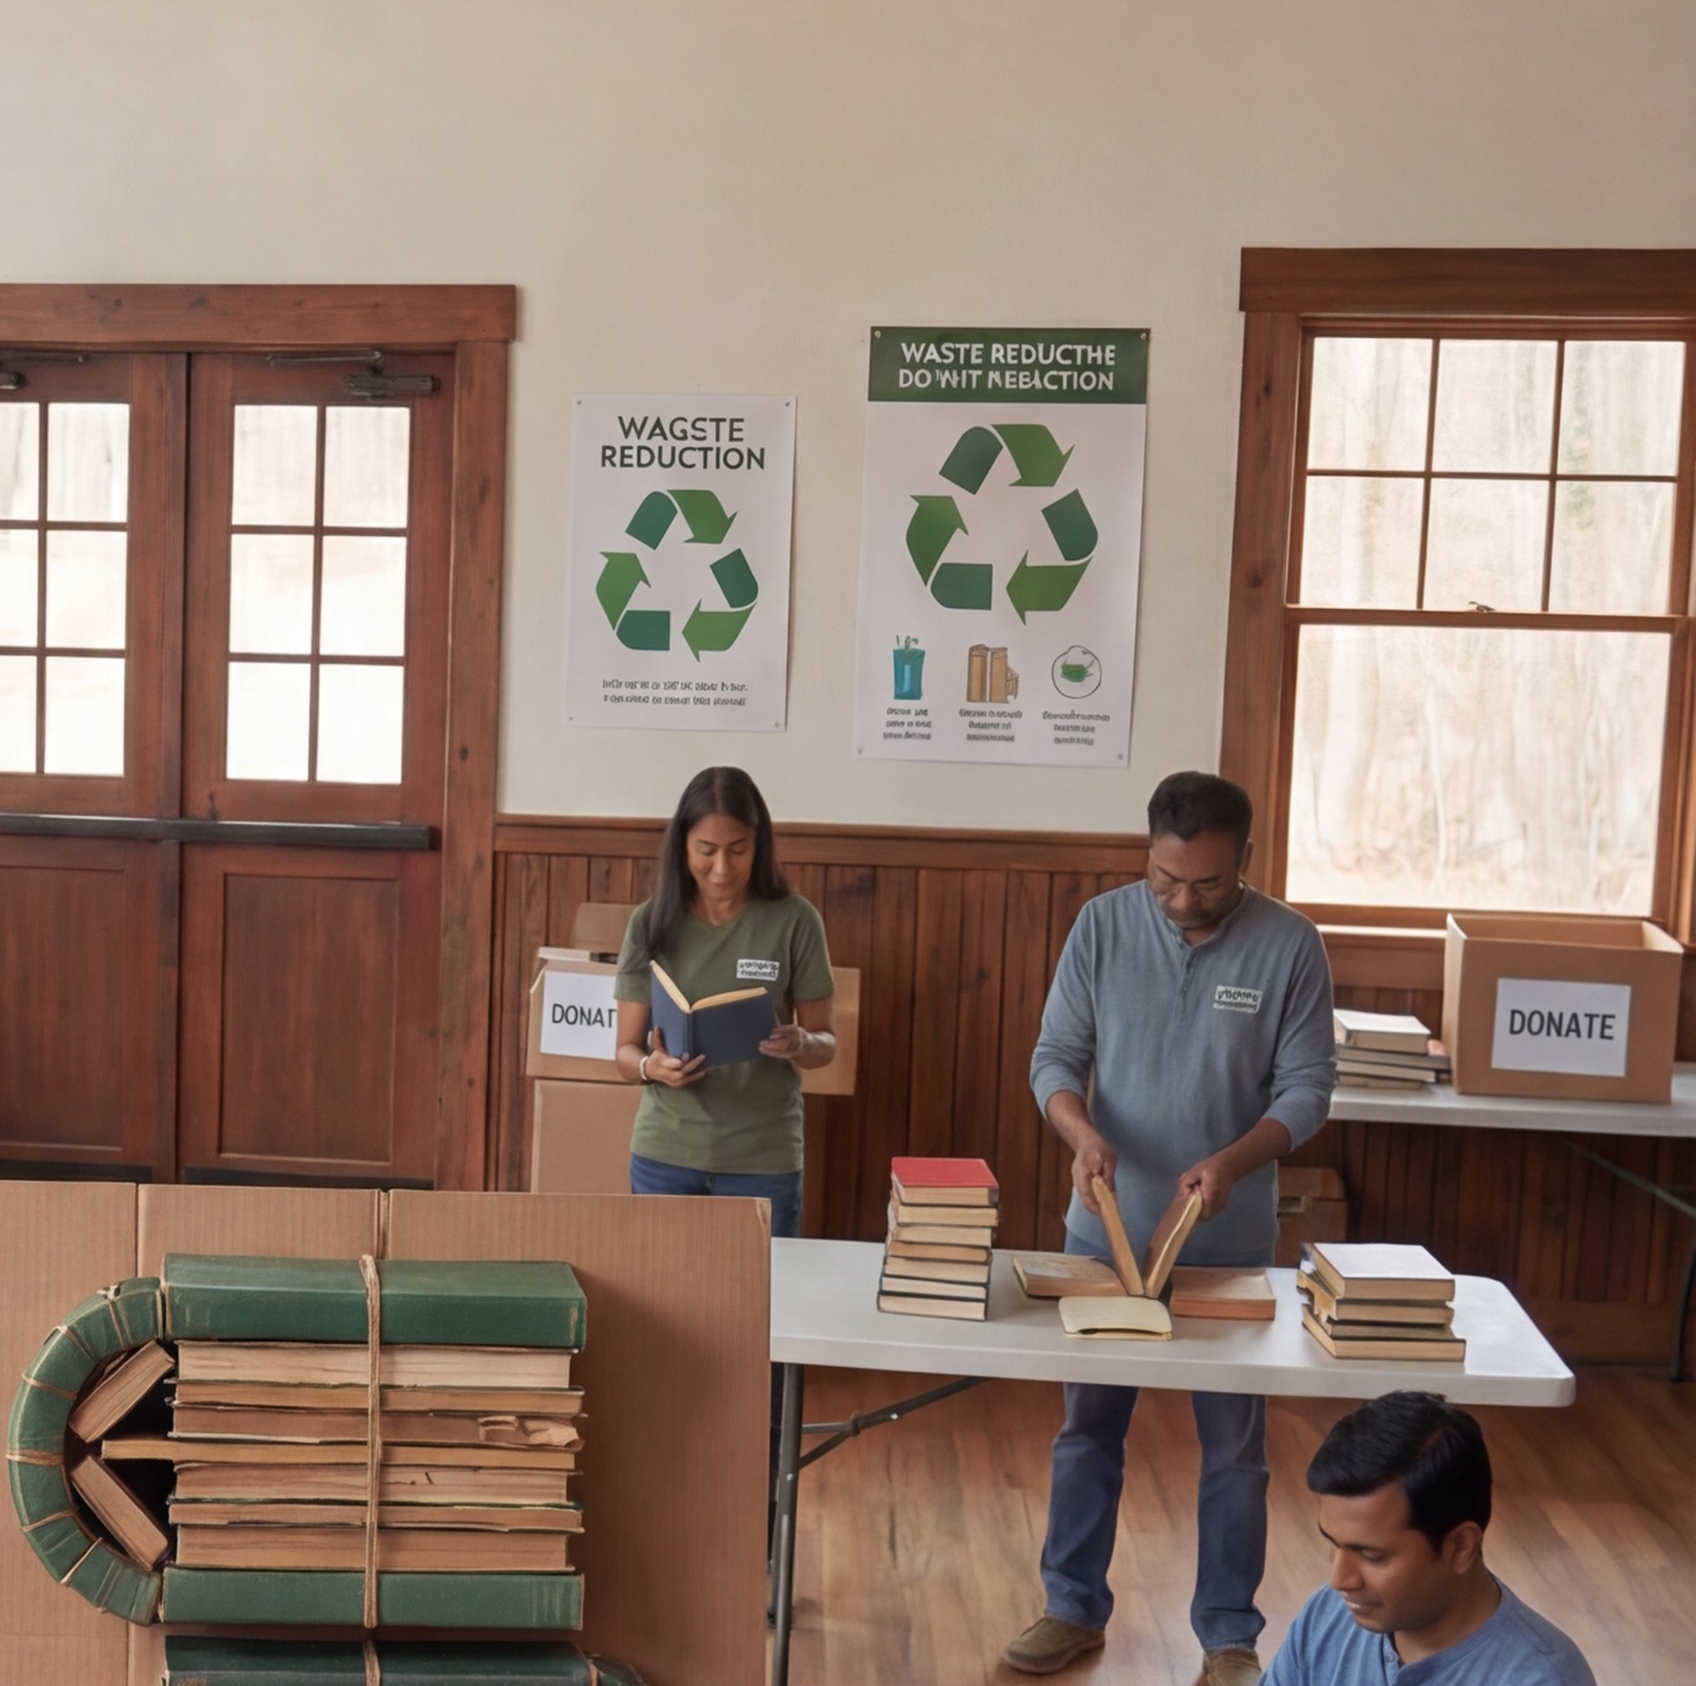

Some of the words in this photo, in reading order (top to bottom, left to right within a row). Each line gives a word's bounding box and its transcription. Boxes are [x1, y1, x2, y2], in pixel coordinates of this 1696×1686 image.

[901, 342, 983, 365] WASTE
[898, 368, 932, 389] DO
[617, 416, 745, 442] WAGSTE
[600, 445, 765, 470] REDUCTION
[552, 1003, 617, 1029] DONAT
[1509, 1008, 1616, 1041] DONATE
